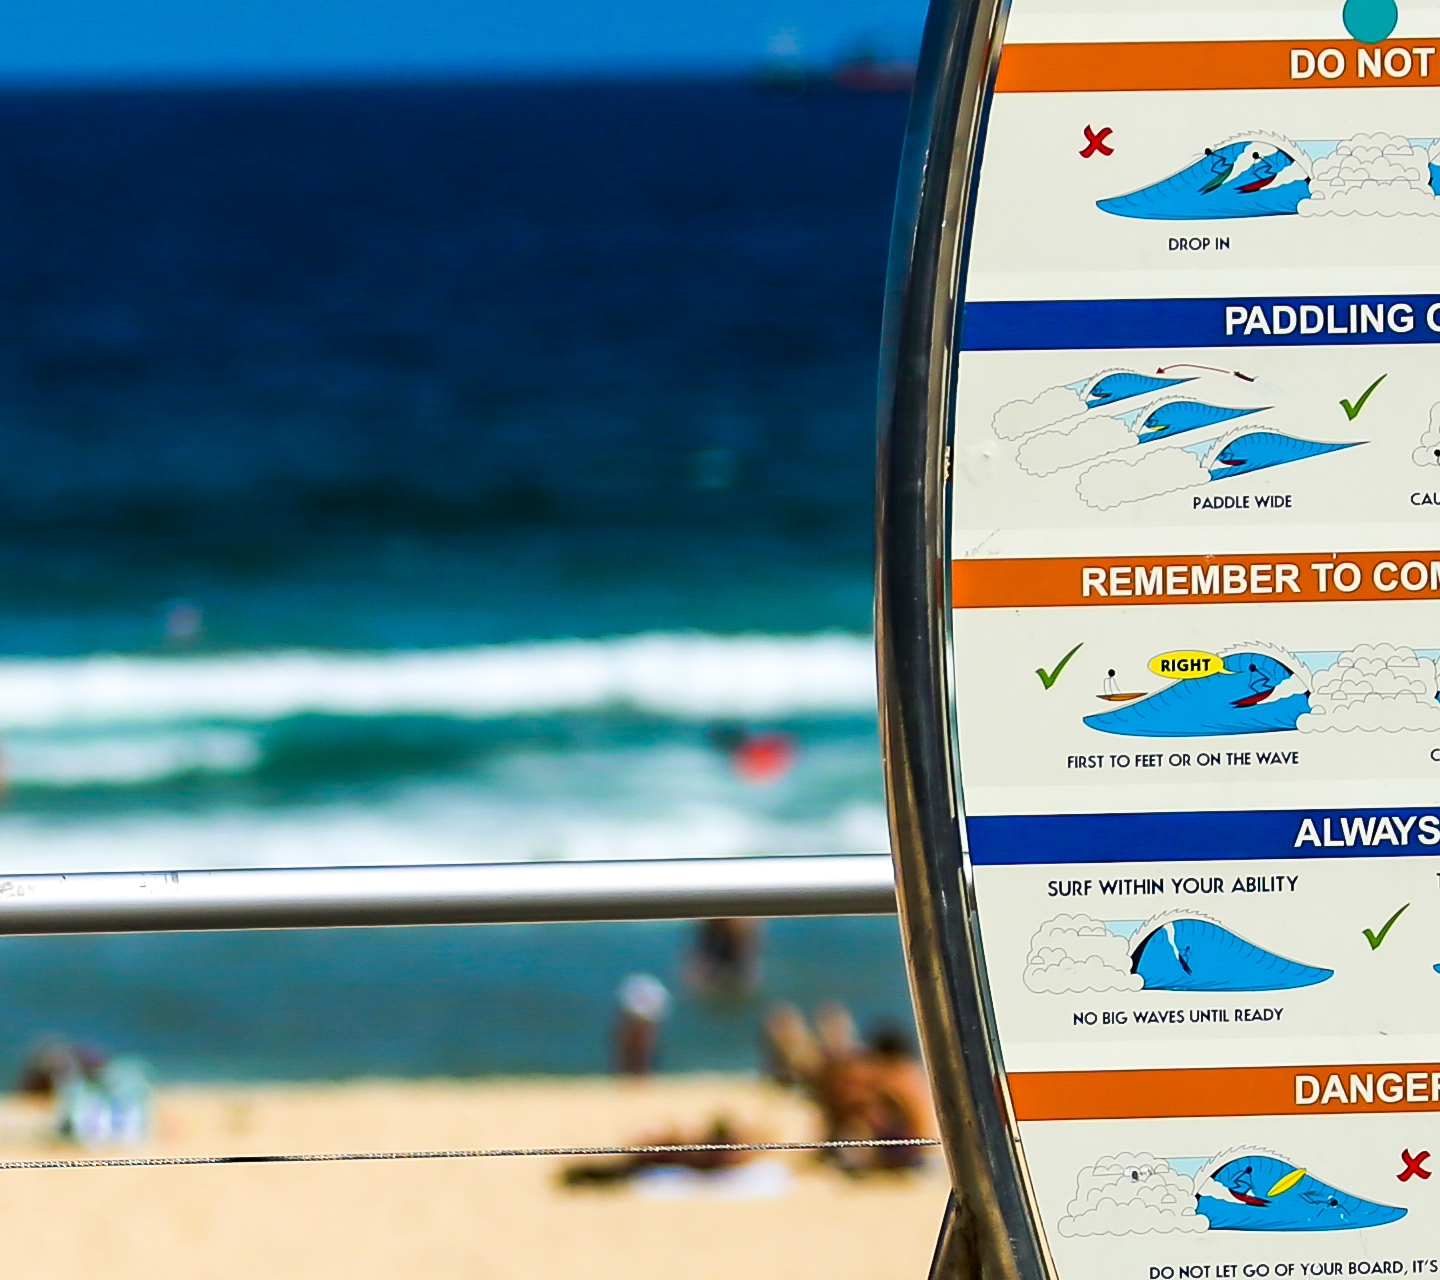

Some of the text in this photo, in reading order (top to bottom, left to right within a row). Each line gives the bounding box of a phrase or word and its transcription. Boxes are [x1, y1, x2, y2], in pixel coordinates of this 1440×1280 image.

[1291, 47, 1436, 79] DO NOT
[1168, 236, 1230, 251] DROP IN
[1225, 303, 1414, 336] PADDLING
[1193, 494, 1292, 510] PADDLE WIDE
[1082, 564, 1301, 597] REMEMBER
[1311, 562, 1361, 592] TO
[1160, 658, 1212, 673] RIGHT
[1067, 751, 1299, 769] FIRST TO FEET OR ON THE WAVE
[1293, 815, 1440, 848] ALWAYS
[1047, 875, 1299, 897] SURF WITHIN YOUR ABILITY
[1073, 1007, 1284, 1026] NO BIG WAVES UNTIL READY
[1149, 1266, 1175, 1280] DO
[1179, 1265, 1211, 1280] NOT
[1215, 1264, 1238, 1278] LET
[1242, 1263, 1270, 1278] GO
[1274, 1263, 1295, 1277] OF
[1300, 1262, 1343, 1276] YOUR
[1348, 1260, 1408, 1278] BOARD,
[1412, 1259, 1439, 1274] IT'S
